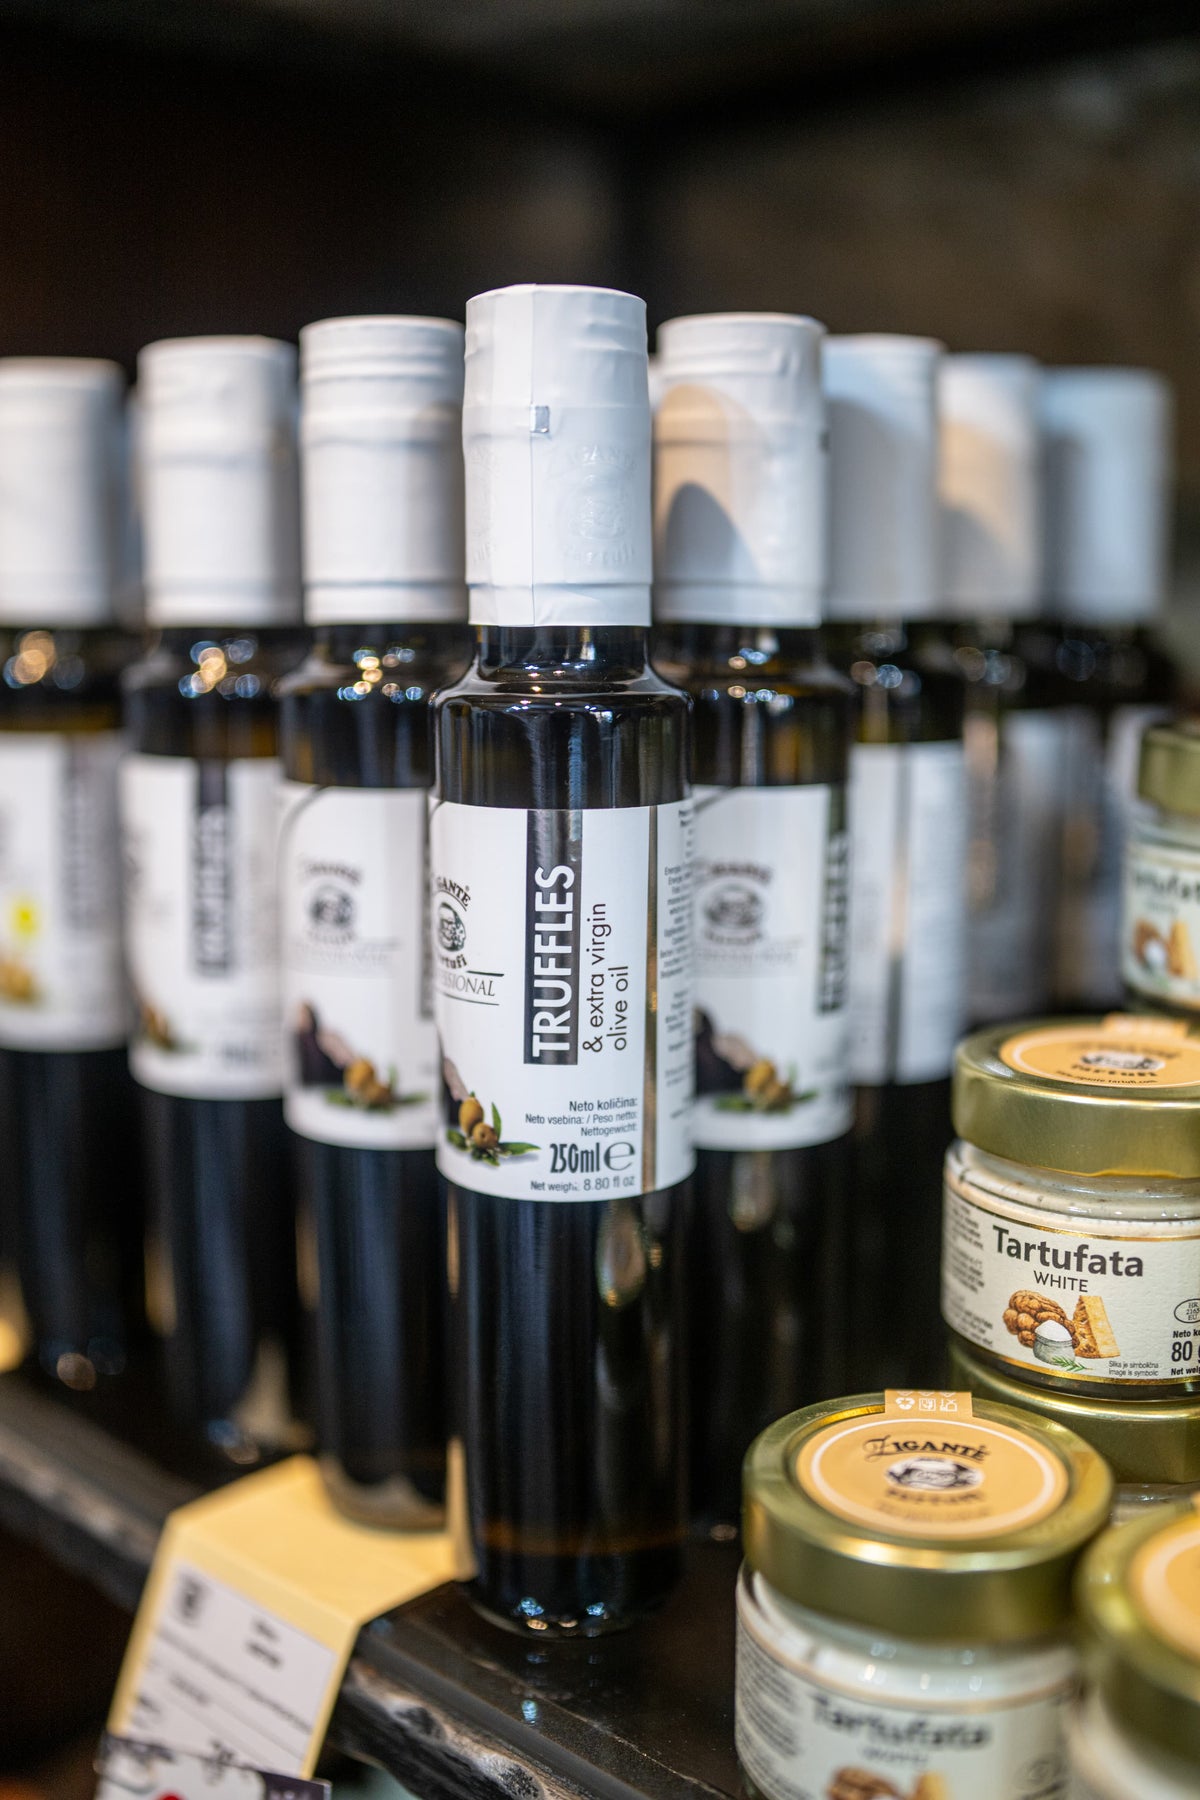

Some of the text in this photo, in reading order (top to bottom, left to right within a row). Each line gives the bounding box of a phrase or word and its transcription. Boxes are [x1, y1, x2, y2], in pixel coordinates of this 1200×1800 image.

[532, 864, 575, 1058] TRUFFLES
[582, 902, 612, 1053] & extra virgin
[606, 966, 629, 1051] olive oil
[569, 1098, 638, 1112] Neto količina:
[525, 1113, 545, 1125] Neto
[593, 1113, 613, 1124] Peso
[549, 1142, 600, 1174] 250ml
[530, 1180, 545, 1191] Net
[583, 1178, 610, 1192] 8.80
[622, 1176, 635, 1187] oz
[993, 1224, 1143, 1277] Tartufata
[1033, 1270, 1089, 1293] WHITE
[1172, 1329, 1191, 1339] Neto
[1171, 1340, 1193, 1362] 80
[1134, 1370, 1159, 1378] symbolic
[1171, 1368, 1184, 1376] Net
